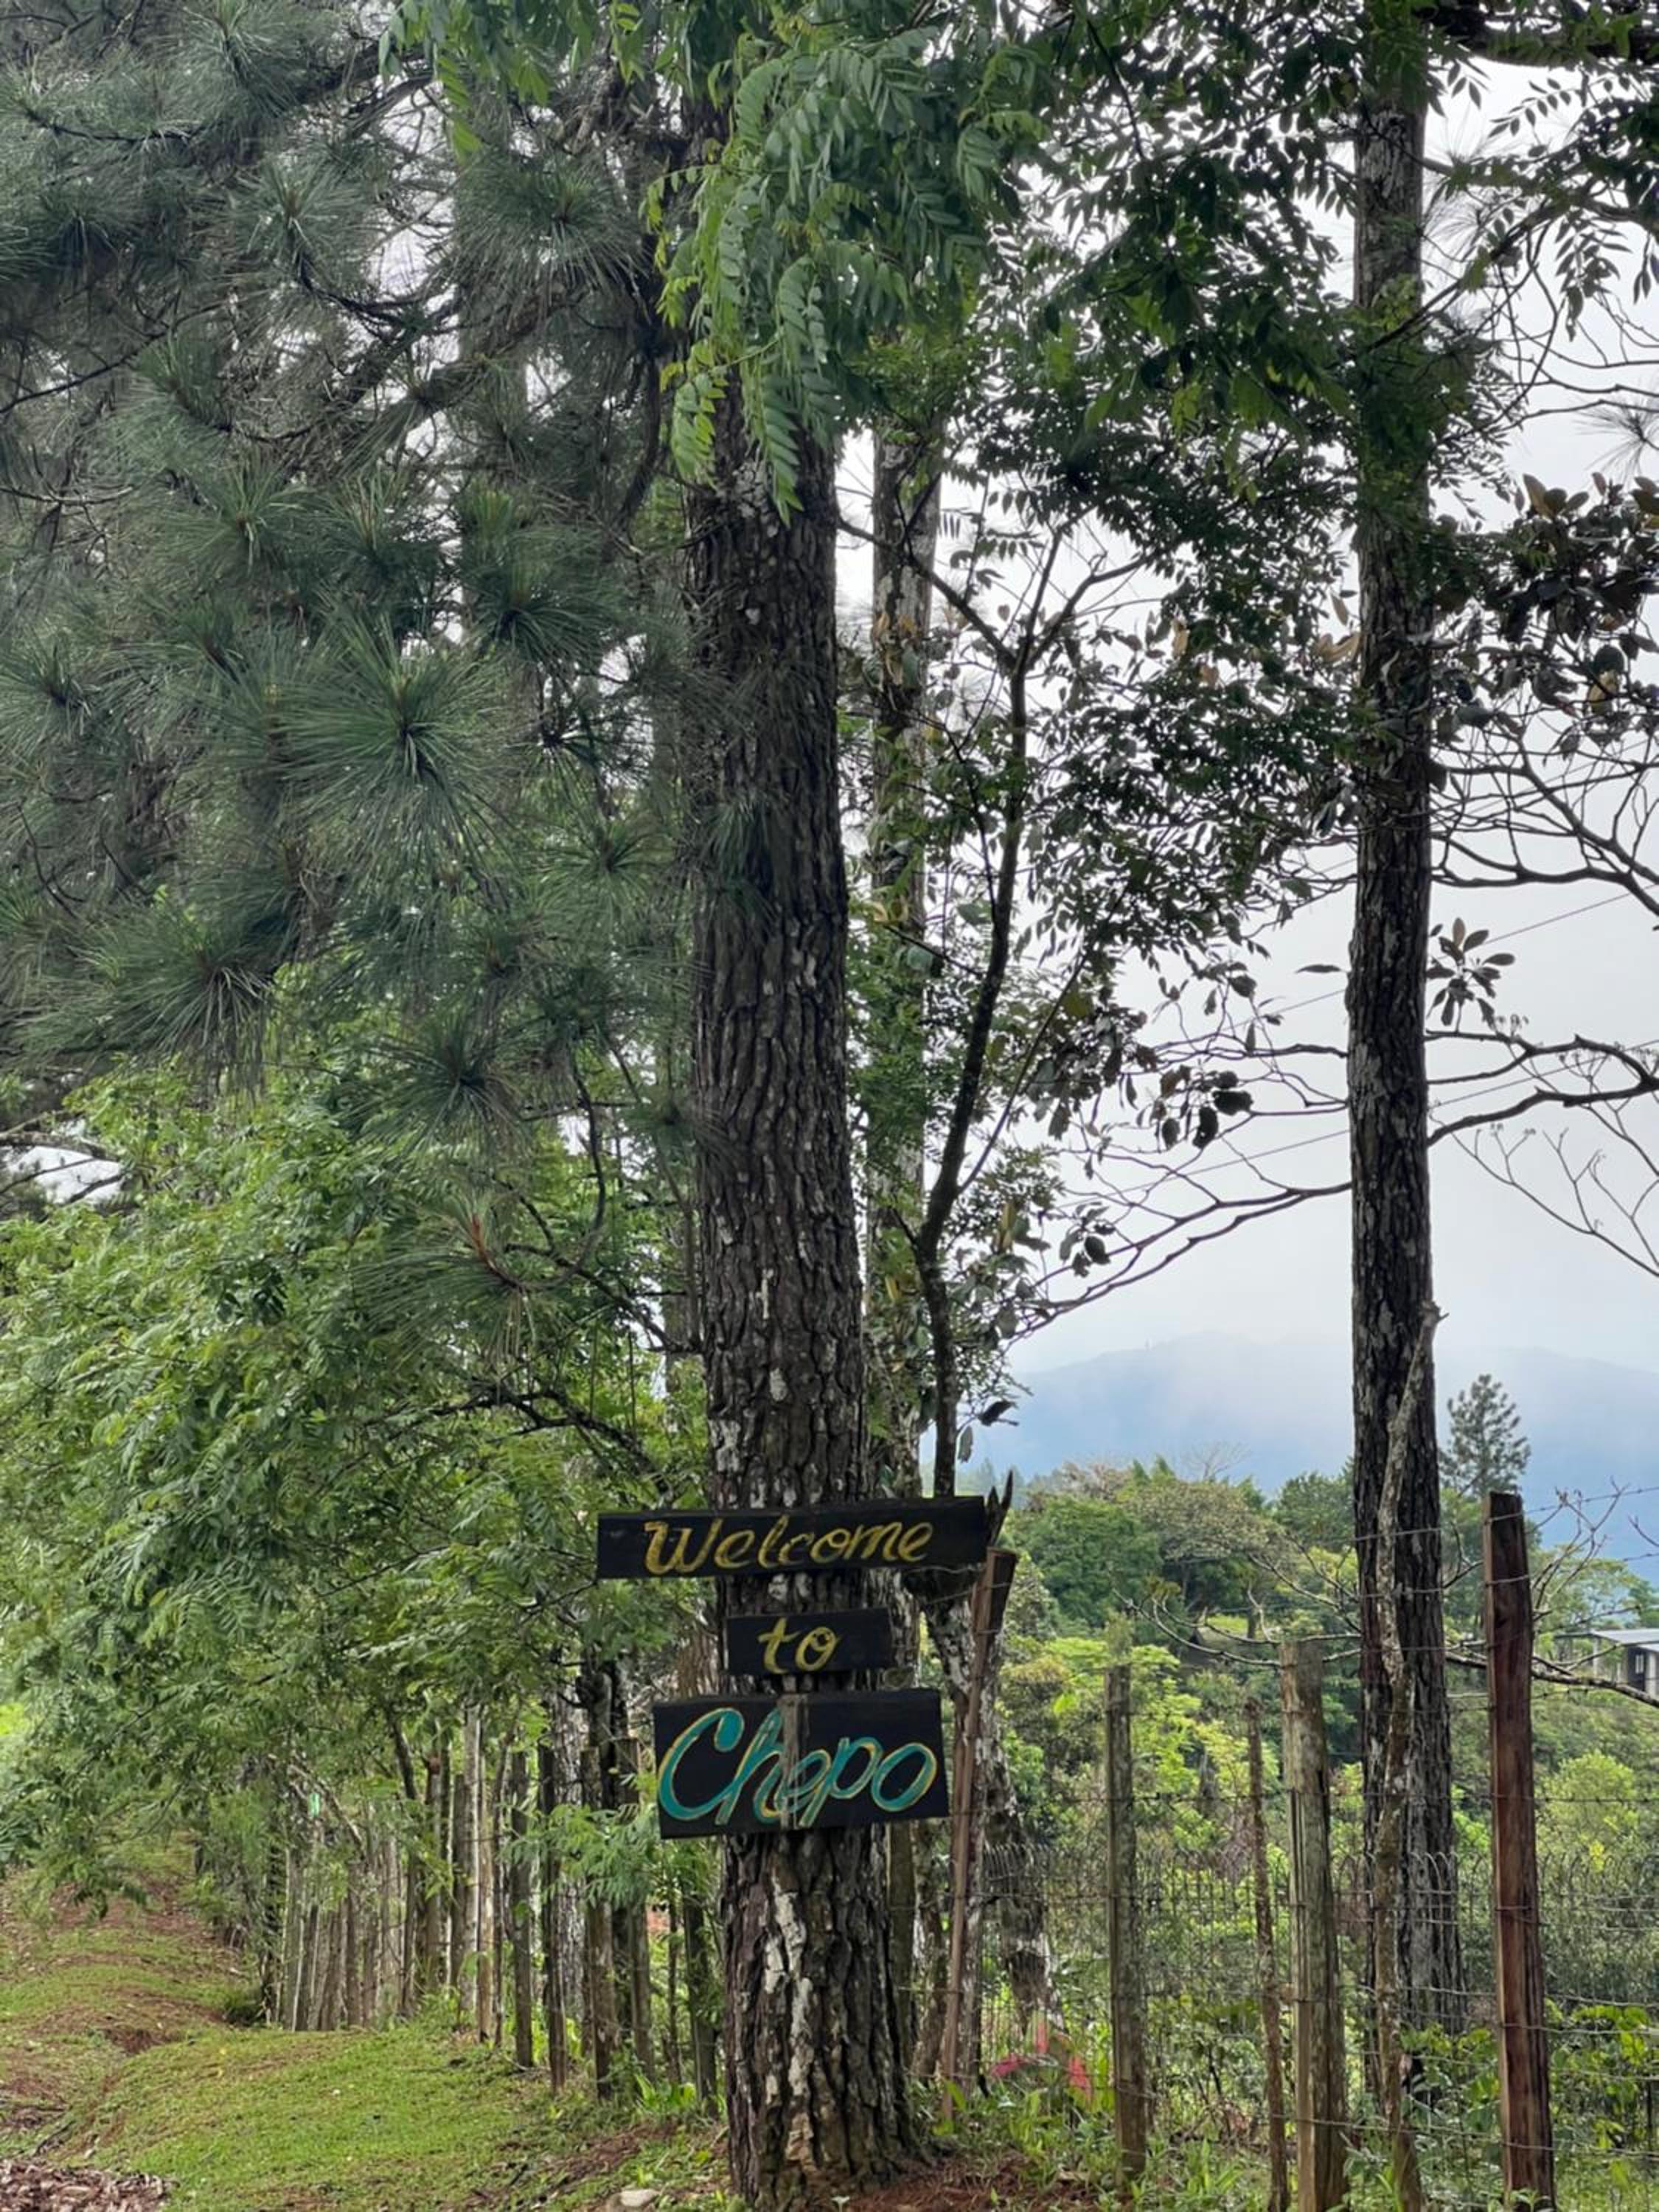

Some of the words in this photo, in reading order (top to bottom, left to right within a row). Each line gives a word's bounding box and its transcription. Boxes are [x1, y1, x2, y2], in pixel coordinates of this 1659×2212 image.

[644, 1514, 933, 1573] Welcome
[758, 1618, 839, 1674] to
[658, 1708, 936, 1827] Chepo
